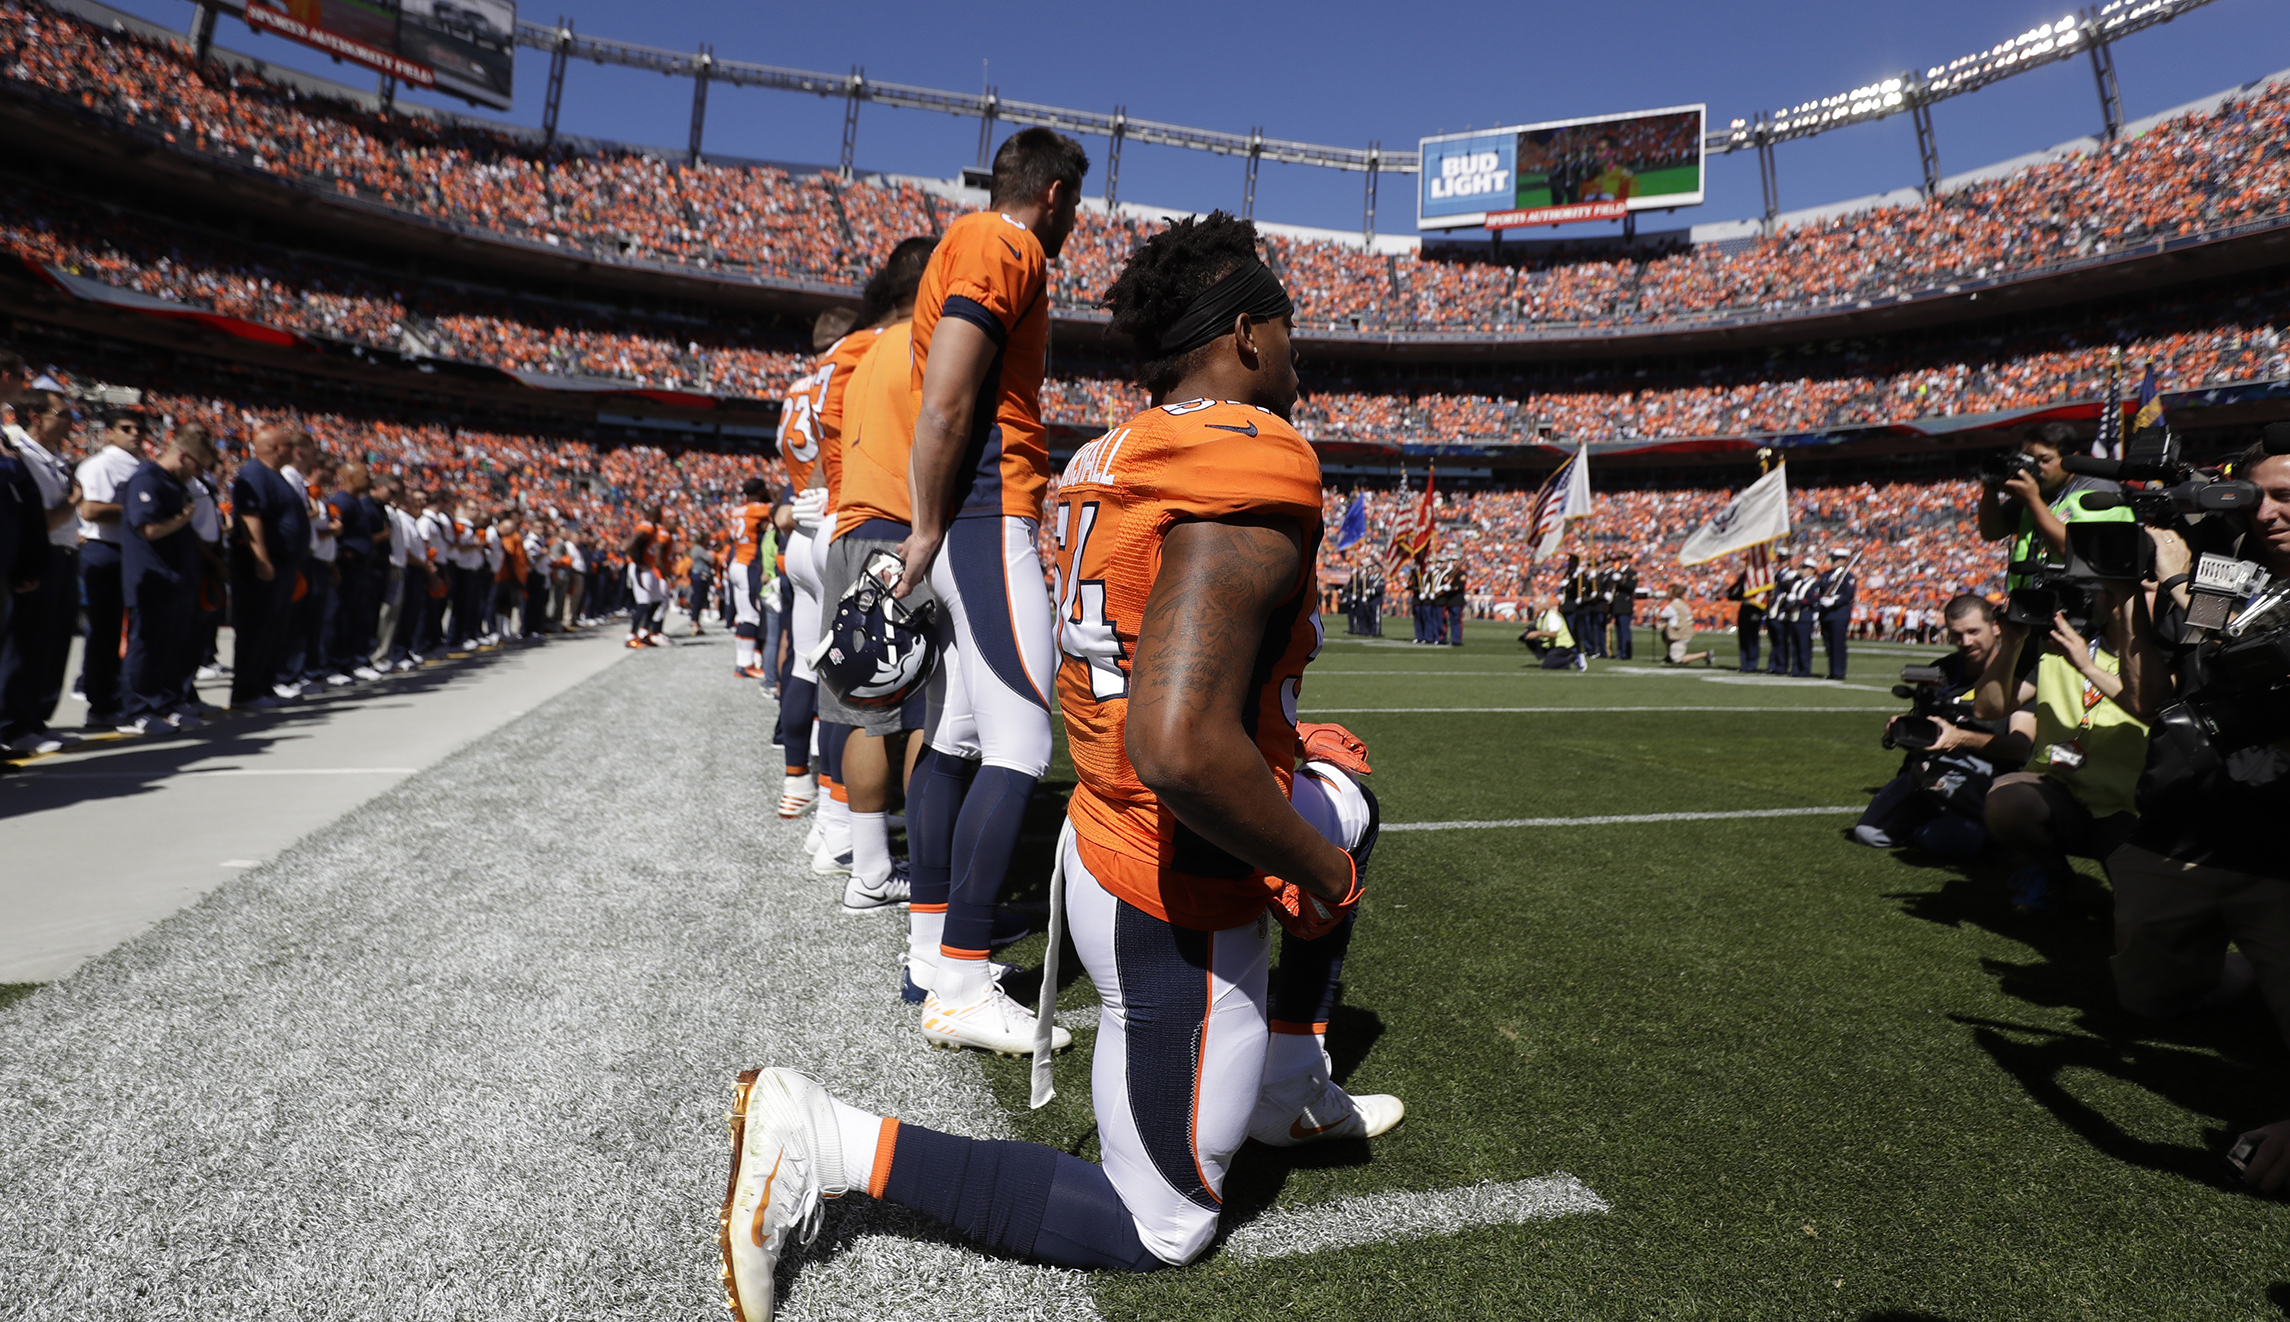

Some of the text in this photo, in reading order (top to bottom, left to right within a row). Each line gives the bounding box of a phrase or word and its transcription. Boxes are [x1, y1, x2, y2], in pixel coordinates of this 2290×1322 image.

[247, 4, 308, 38] SPORTS
[308, 27, 394, 70] AUTHORITY
[394, 58, 434, 84] FIELD
[1441, 152, 1499, 179] BUD
[1430, 169, 1510, 199] LIGHT
[1486, 202, 1627, 227] SPORTS AUTHORITY FIELD
